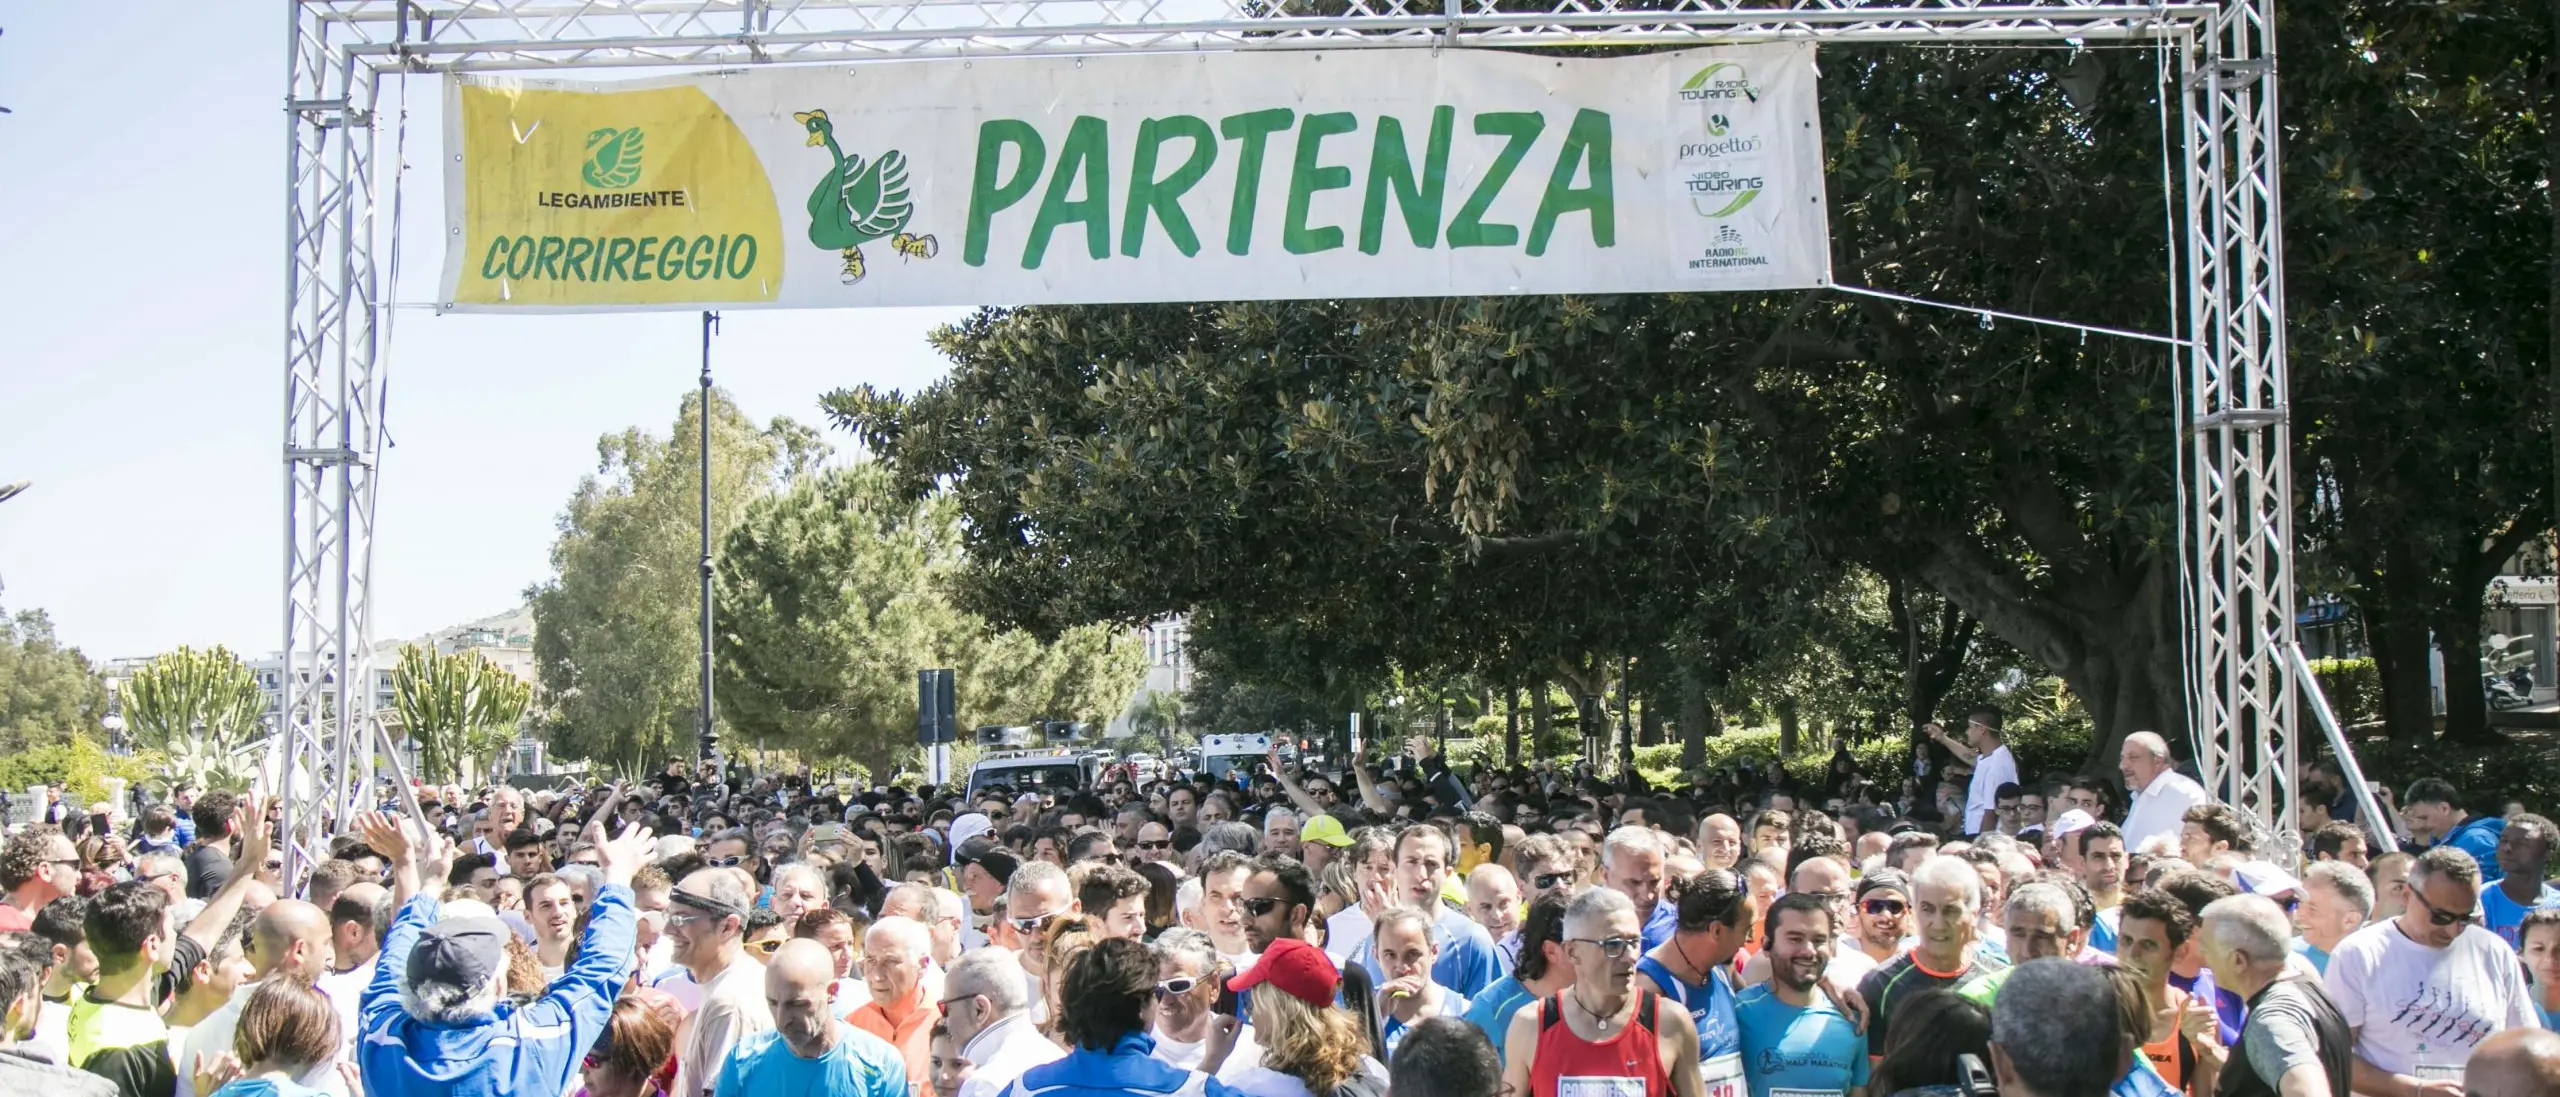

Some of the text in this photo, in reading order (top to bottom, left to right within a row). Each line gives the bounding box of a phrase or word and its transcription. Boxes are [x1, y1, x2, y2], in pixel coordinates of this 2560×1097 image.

[1715, 80, 1749, 89] RADIO
[962, 104, 1616, 270] PARTENZA
[1684, 176, 1764, 192] TOURING
[537, 189, 686, 209] LEGAMBIENTE
[481, 232, 758, 282] CORRIREGGIO
[1688, 256, 1769, 270] INTERNATIONAL
